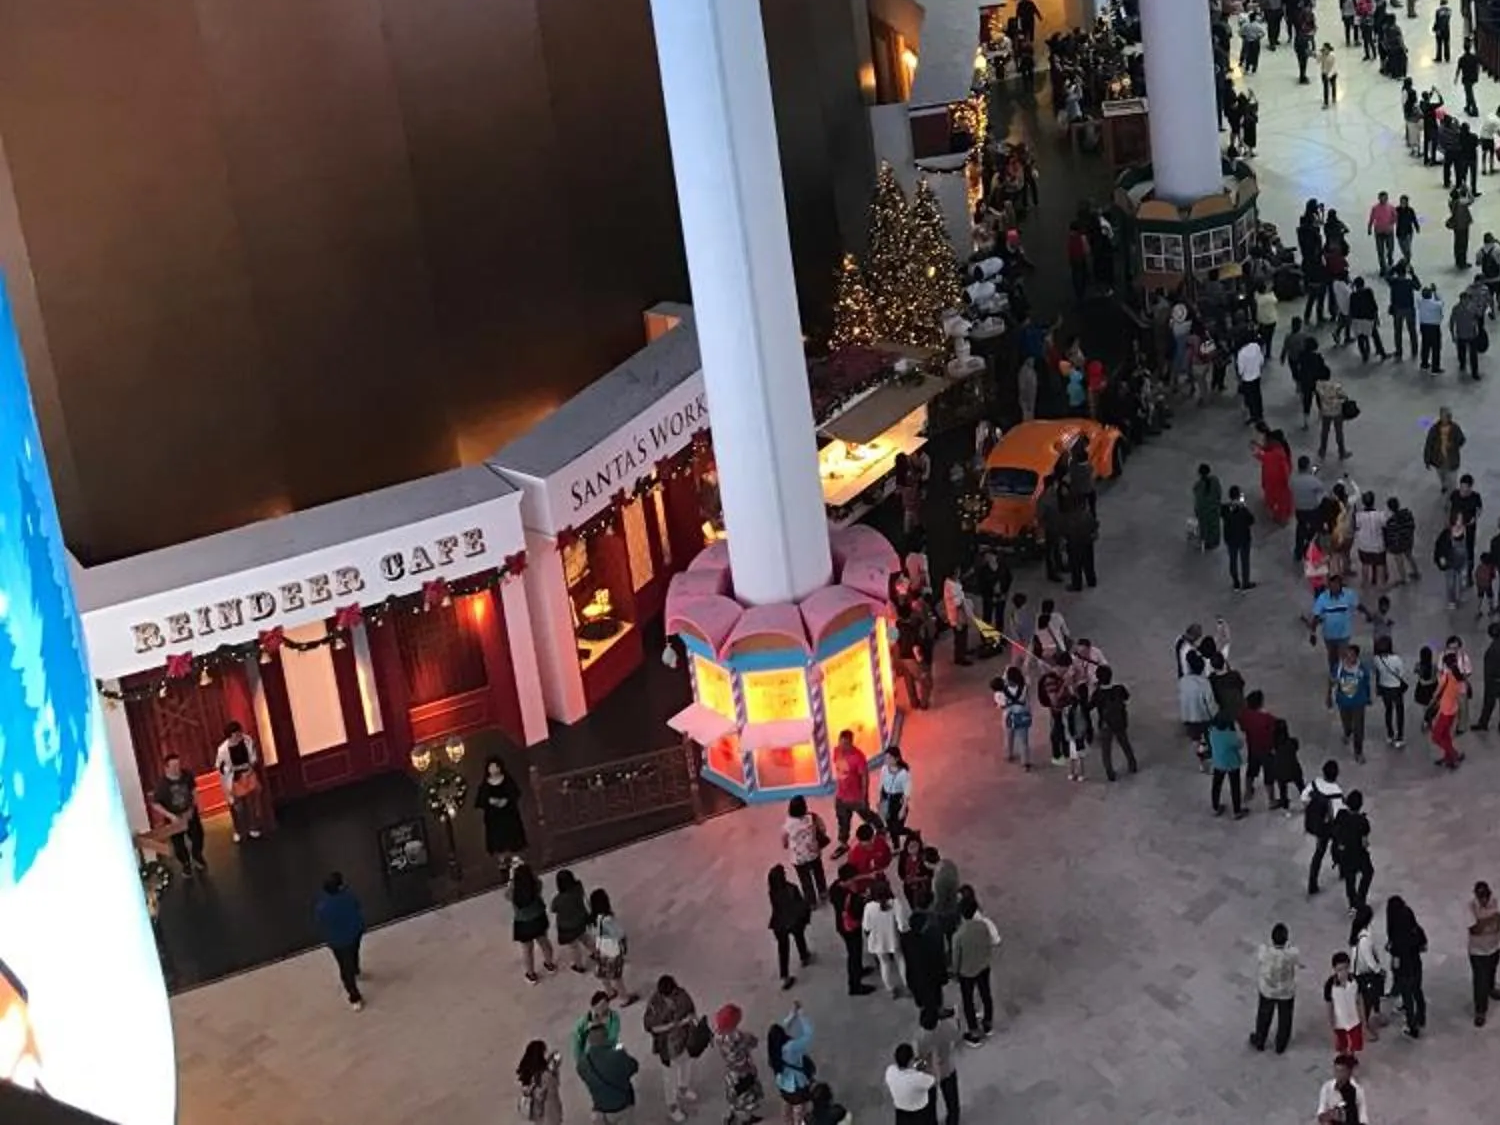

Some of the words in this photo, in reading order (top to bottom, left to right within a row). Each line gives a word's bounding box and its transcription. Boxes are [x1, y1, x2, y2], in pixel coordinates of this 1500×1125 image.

[570, 435, 648, 512] SANTA'S
[132, 566, 366, 653] REINDEER
[379, 527, 487, 581] CAFE
